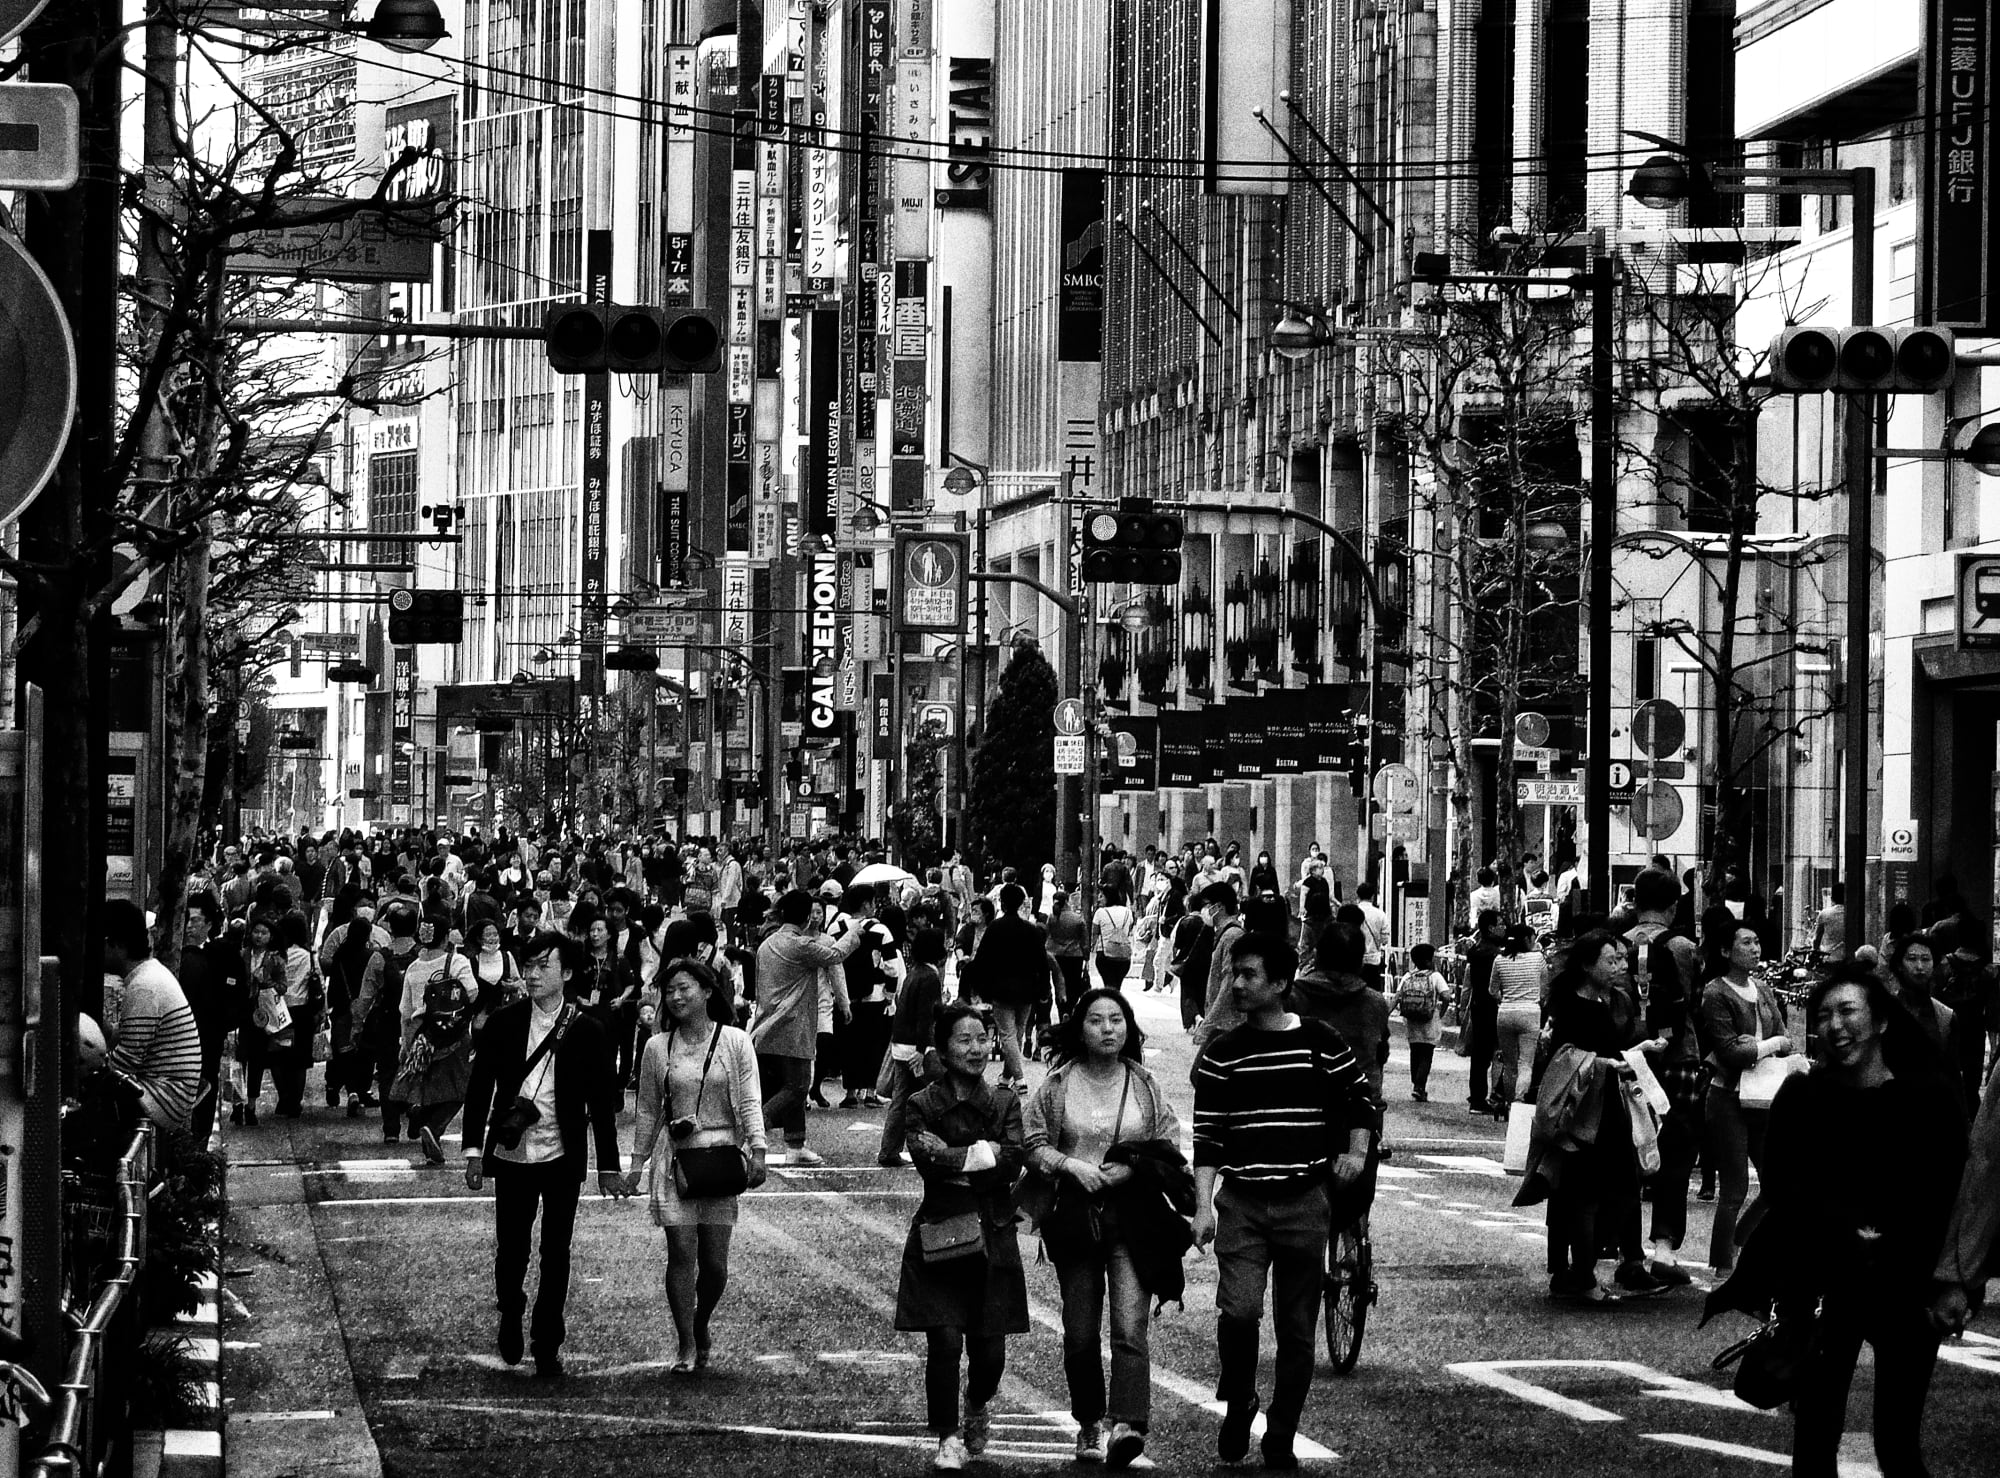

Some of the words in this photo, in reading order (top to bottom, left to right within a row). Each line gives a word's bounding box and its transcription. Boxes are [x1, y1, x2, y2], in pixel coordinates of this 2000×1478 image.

[868, 8, 884, 74] なんぼや
[1947, 17, 1977, 203] 三菱UFJ銀行
[811, 150, 825, 274] みずのクリニック
[901, 198, 923, 208] MUJI
[735, 181, 751, 274] 三井住友銀行
[672, 237, 688, 249] 5F
[671, 261, 687, 273] 7F
[812, 278, 830, 289] 8F
[1063, 273, 1104, 288] SMBC
[669, 405, 683, 473] KEYUCA
[828, 401, 840, 464] LEGWEAR
[901, 445, 915, 453] 4F
[827, 466, 838, 517] ITALIAN
[670, 496, 680, 515] THE
[670, 519, 680, 540] SUIT
[786, 518, 798, 557] AOKI
[841, 560, 850, 587] Free
[840, 588, 850, 608] Tax
[1276, 758, 1298, 767] ISETAN
